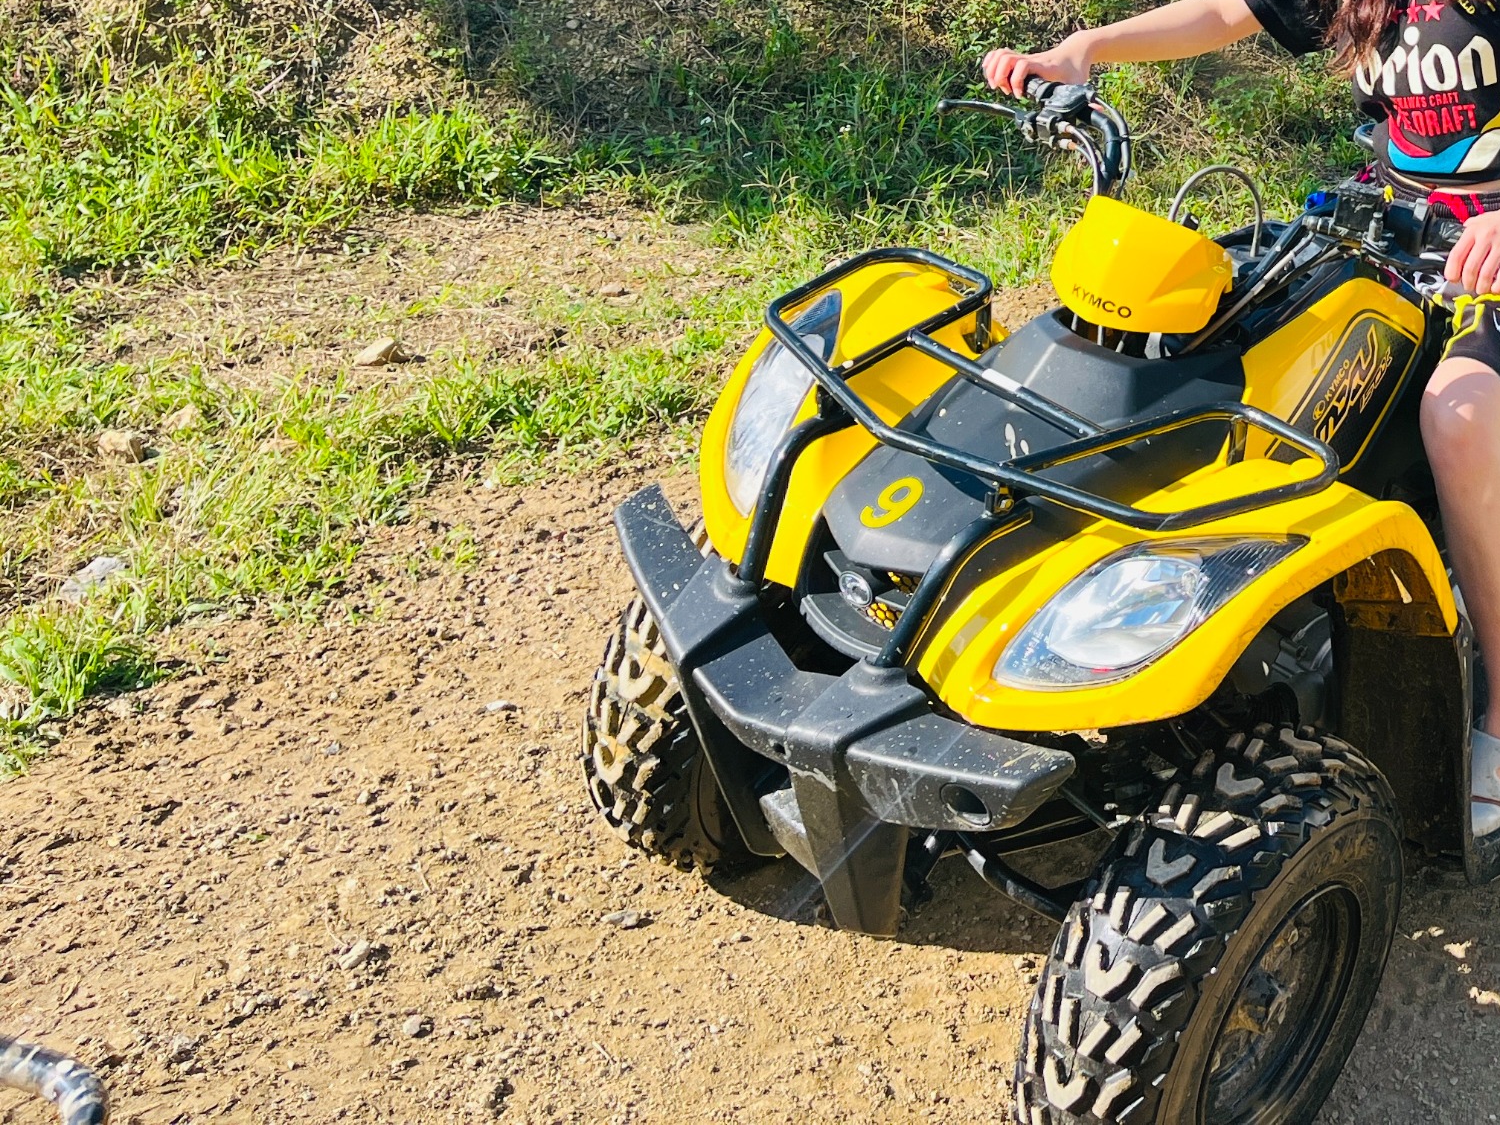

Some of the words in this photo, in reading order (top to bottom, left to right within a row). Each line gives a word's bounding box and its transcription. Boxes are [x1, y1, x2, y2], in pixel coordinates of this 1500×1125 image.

[1429, 91, 1459, 107] CRAFT
[1072, 283, 1132, 319] KYMCO
[1324, 358, 1350, 402] KYMCO
[859, 476, 924, 529] 9
